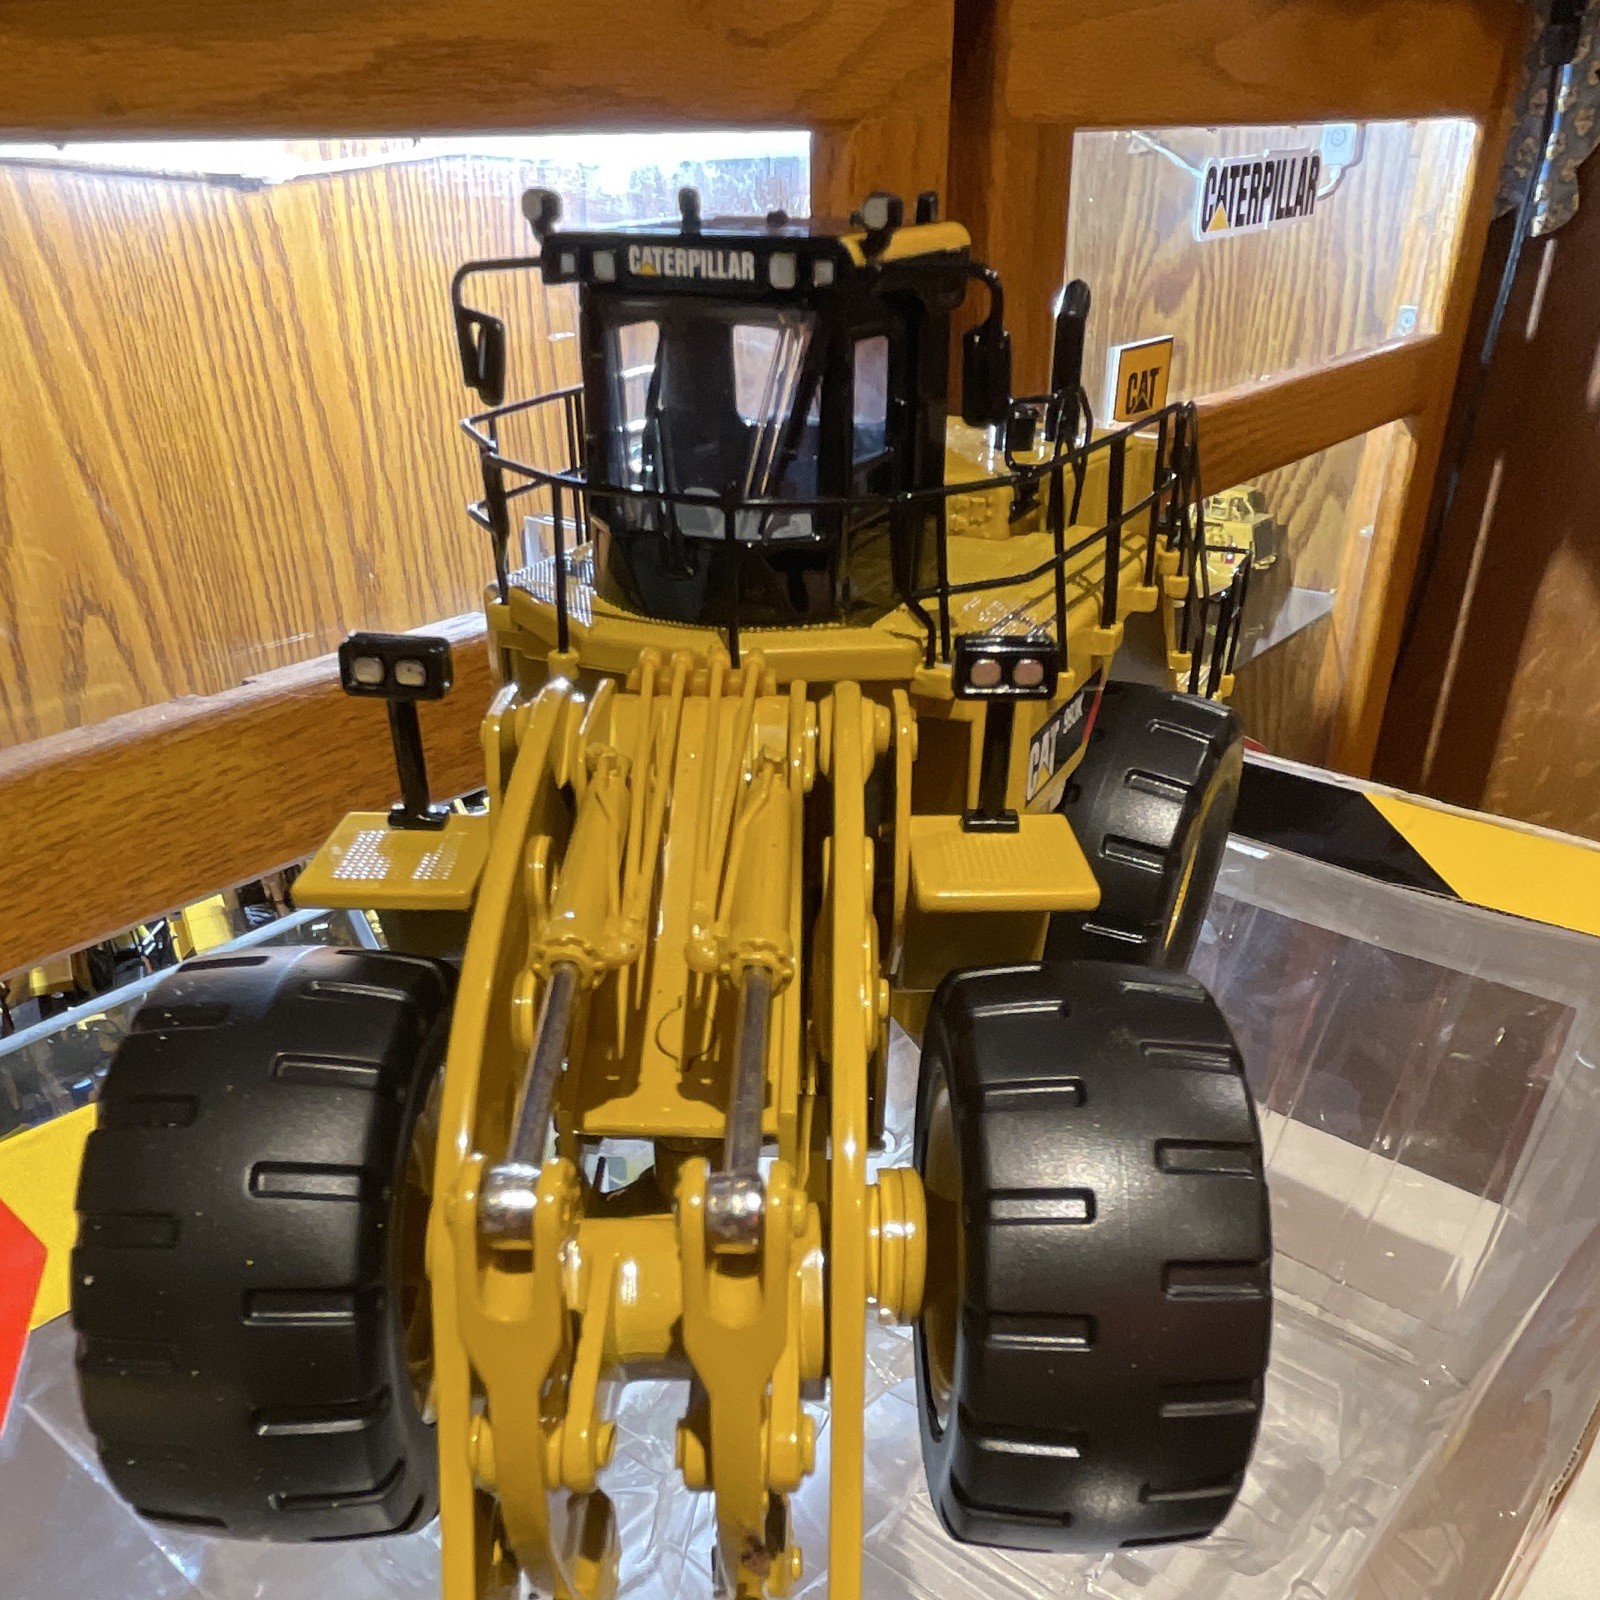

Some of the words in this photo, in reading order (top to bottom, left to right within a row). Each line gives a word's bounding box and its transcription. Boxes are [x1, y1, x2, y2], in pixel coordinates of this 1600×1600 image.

[1201, 155, 1321, 233] CATERPILLAR
[629, 244, 755, 281] CATERPILLAR
[1125, 367, 1161, 415] CAT
[1026, 719, 1060, 801] CAT
